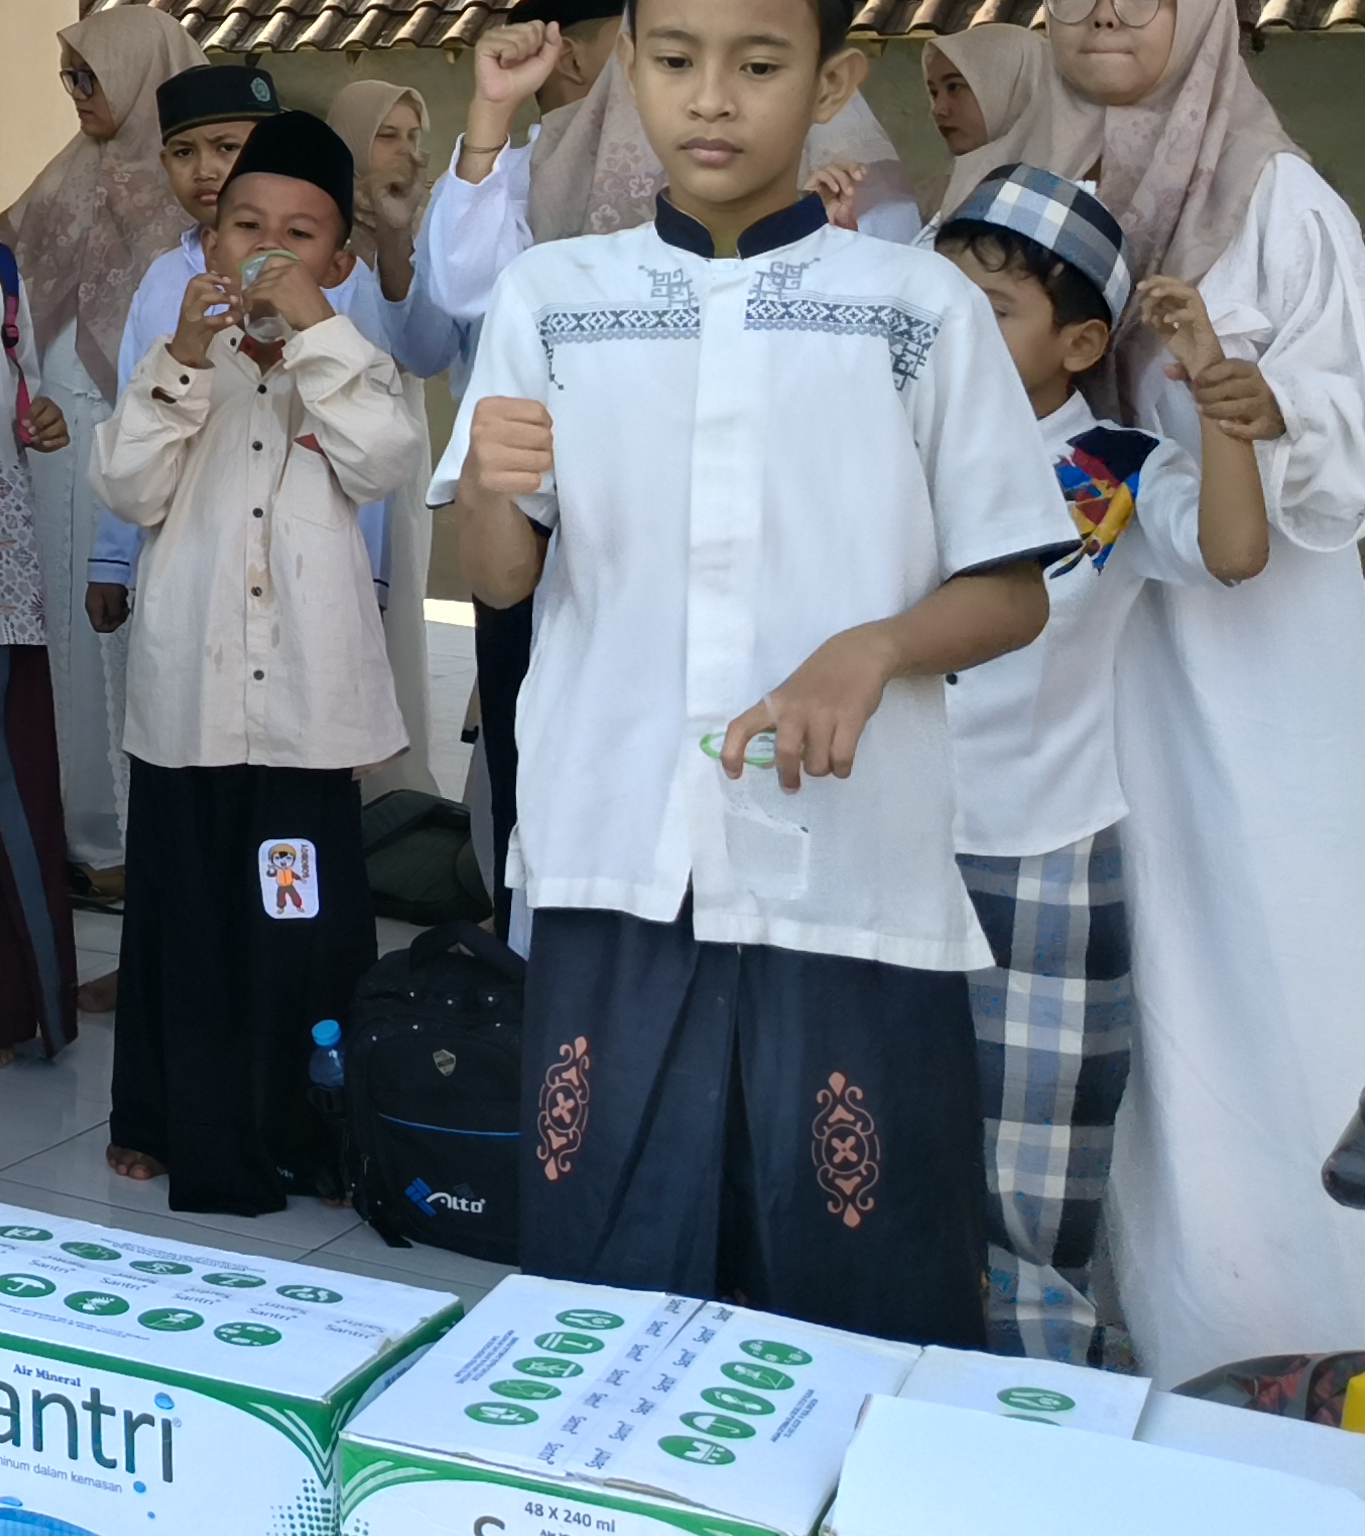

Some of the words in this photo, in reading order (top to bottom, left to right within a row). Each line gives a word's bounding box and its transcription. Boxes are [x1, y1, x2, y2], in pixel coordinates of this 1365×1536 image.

[13, 1363, 33, 1377] Air
[35, 1368, 81, 1387] Mineral
[33, 1461, 68, 1481] dalam
[70, 1471, 123, 1493] kemasan
[524, 1501, 544, 1517] 48
[563, 1509, 592, 1527] 240
[596, 1519, 615, 1533] ml
